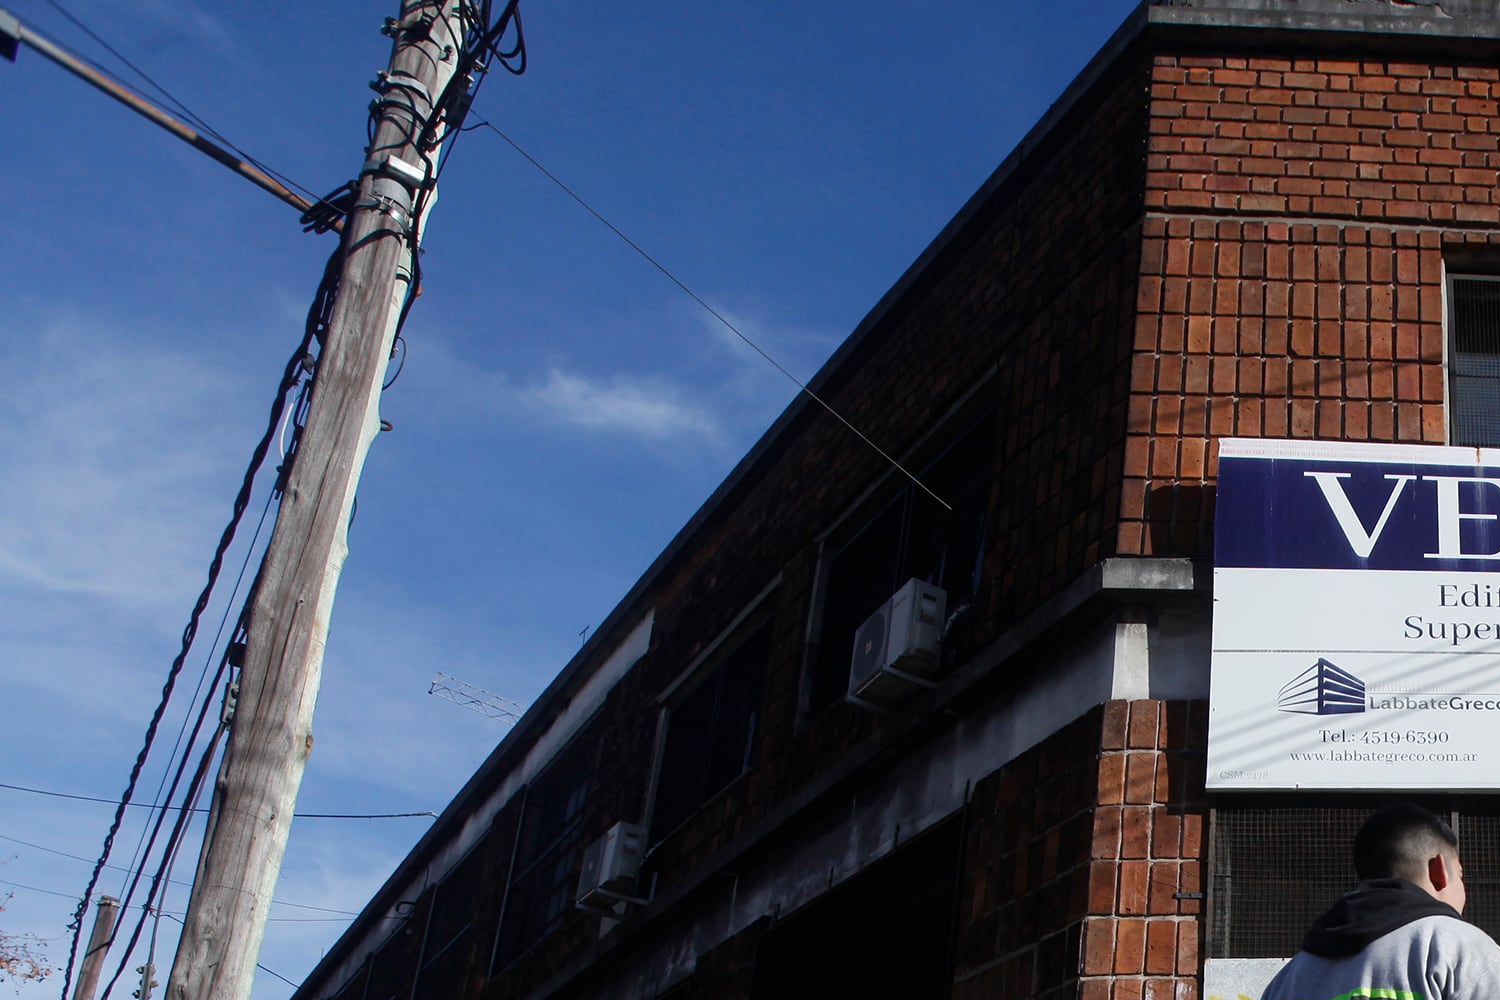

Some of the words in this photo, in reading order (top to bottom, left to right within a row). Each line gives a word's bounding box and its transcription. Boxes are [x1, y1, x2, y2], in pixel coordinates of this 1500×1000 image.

[1318, 728, 1356, 744] Tel.:
[1359, 729, 1450, 745] 4519-6390
[1289, 750, 1479, 764] www.labbategreco.com.ar
